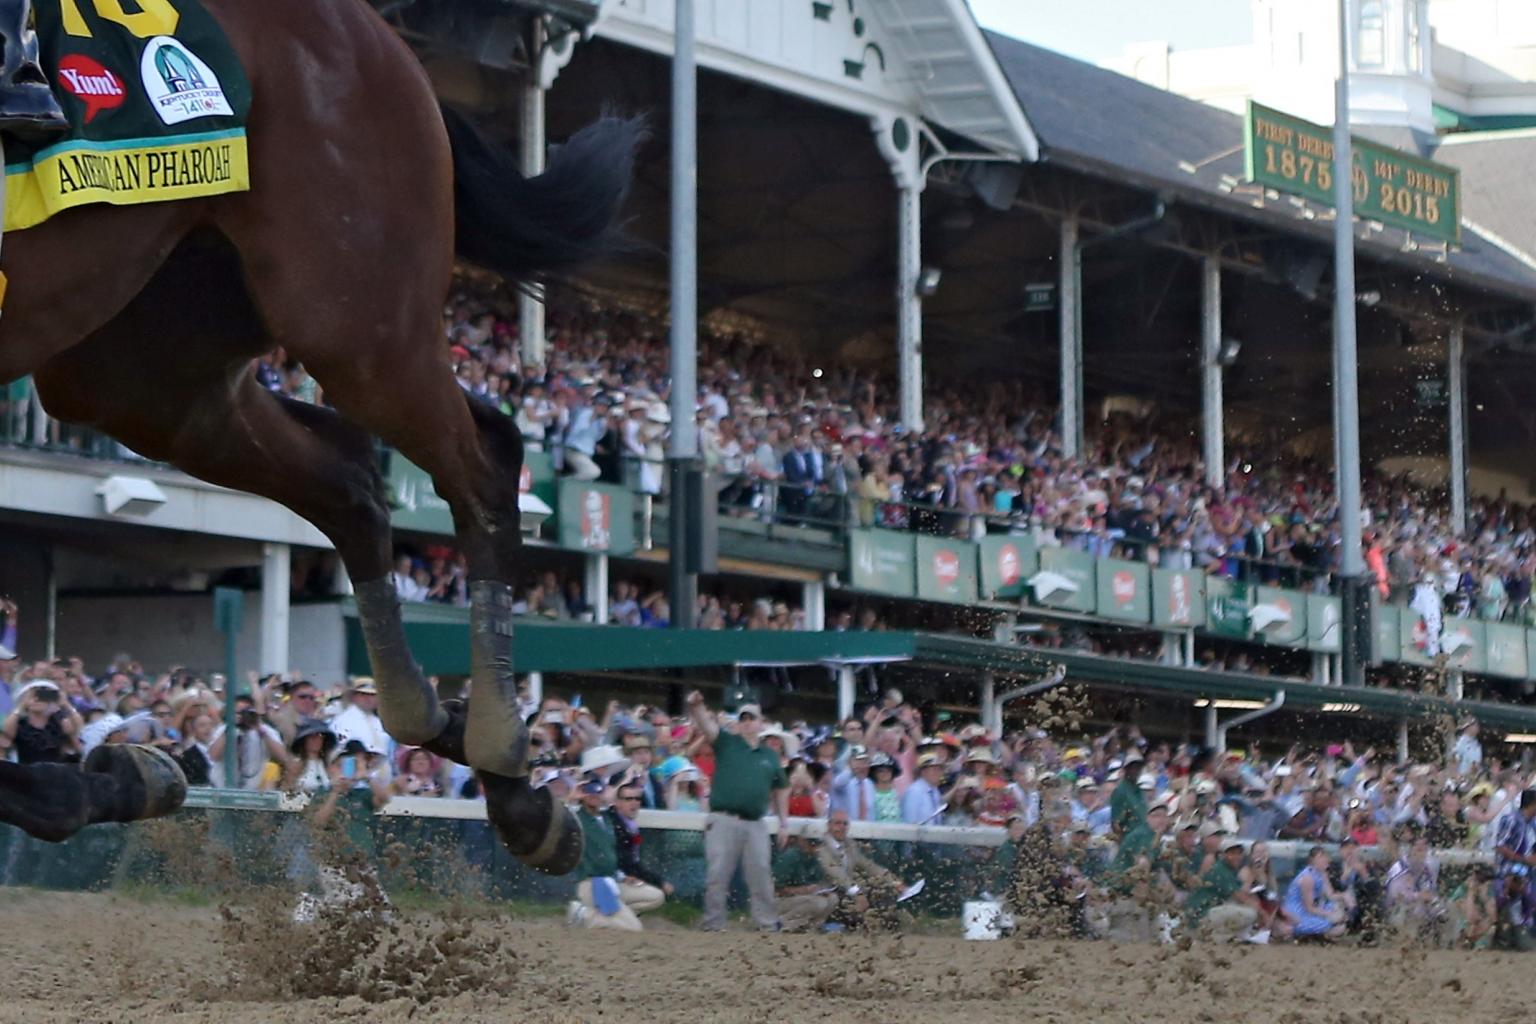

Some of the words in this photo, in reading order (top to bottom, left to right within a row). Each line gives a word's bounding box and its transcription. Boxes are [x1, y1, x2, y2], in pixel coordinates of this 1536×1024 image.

[60, 69, 121, 96] Yum!
[1256, 118, 1293, 146] FIRST
[145, 144, 231, 189] PHAROAH
[1265, 145, 1332, 190] 1875
[1406, 169, 1449, 198] DERBY
[1380, 183, 1439, 224] 2015
